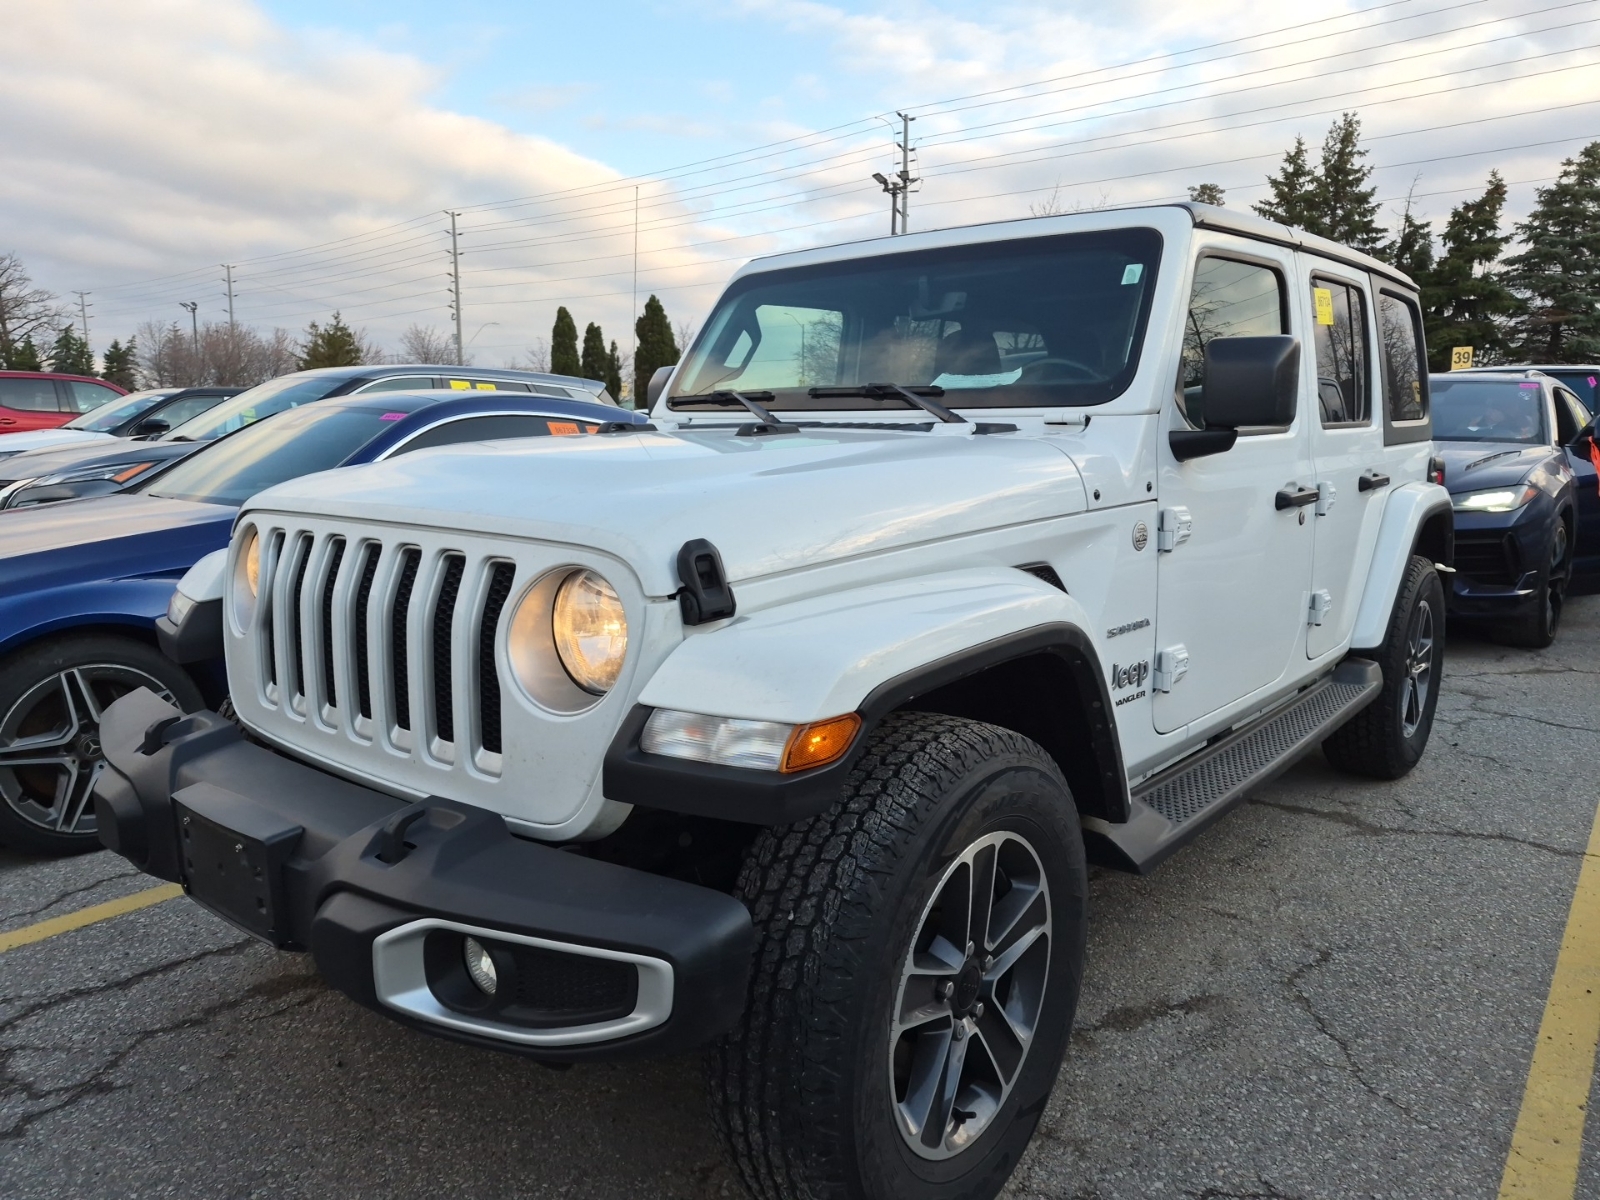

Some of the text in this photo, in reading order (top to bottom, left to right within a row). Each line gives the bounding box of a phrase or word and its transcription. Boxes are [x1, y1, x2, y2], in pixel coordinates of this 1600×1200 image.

[1453, 351, 1471, 364] 39
[1107, 618, 1150, 638] SAHARA
[1111, 659, 1149, 691] Jeep
[1115, 690, 1146, 707] ANGLER
